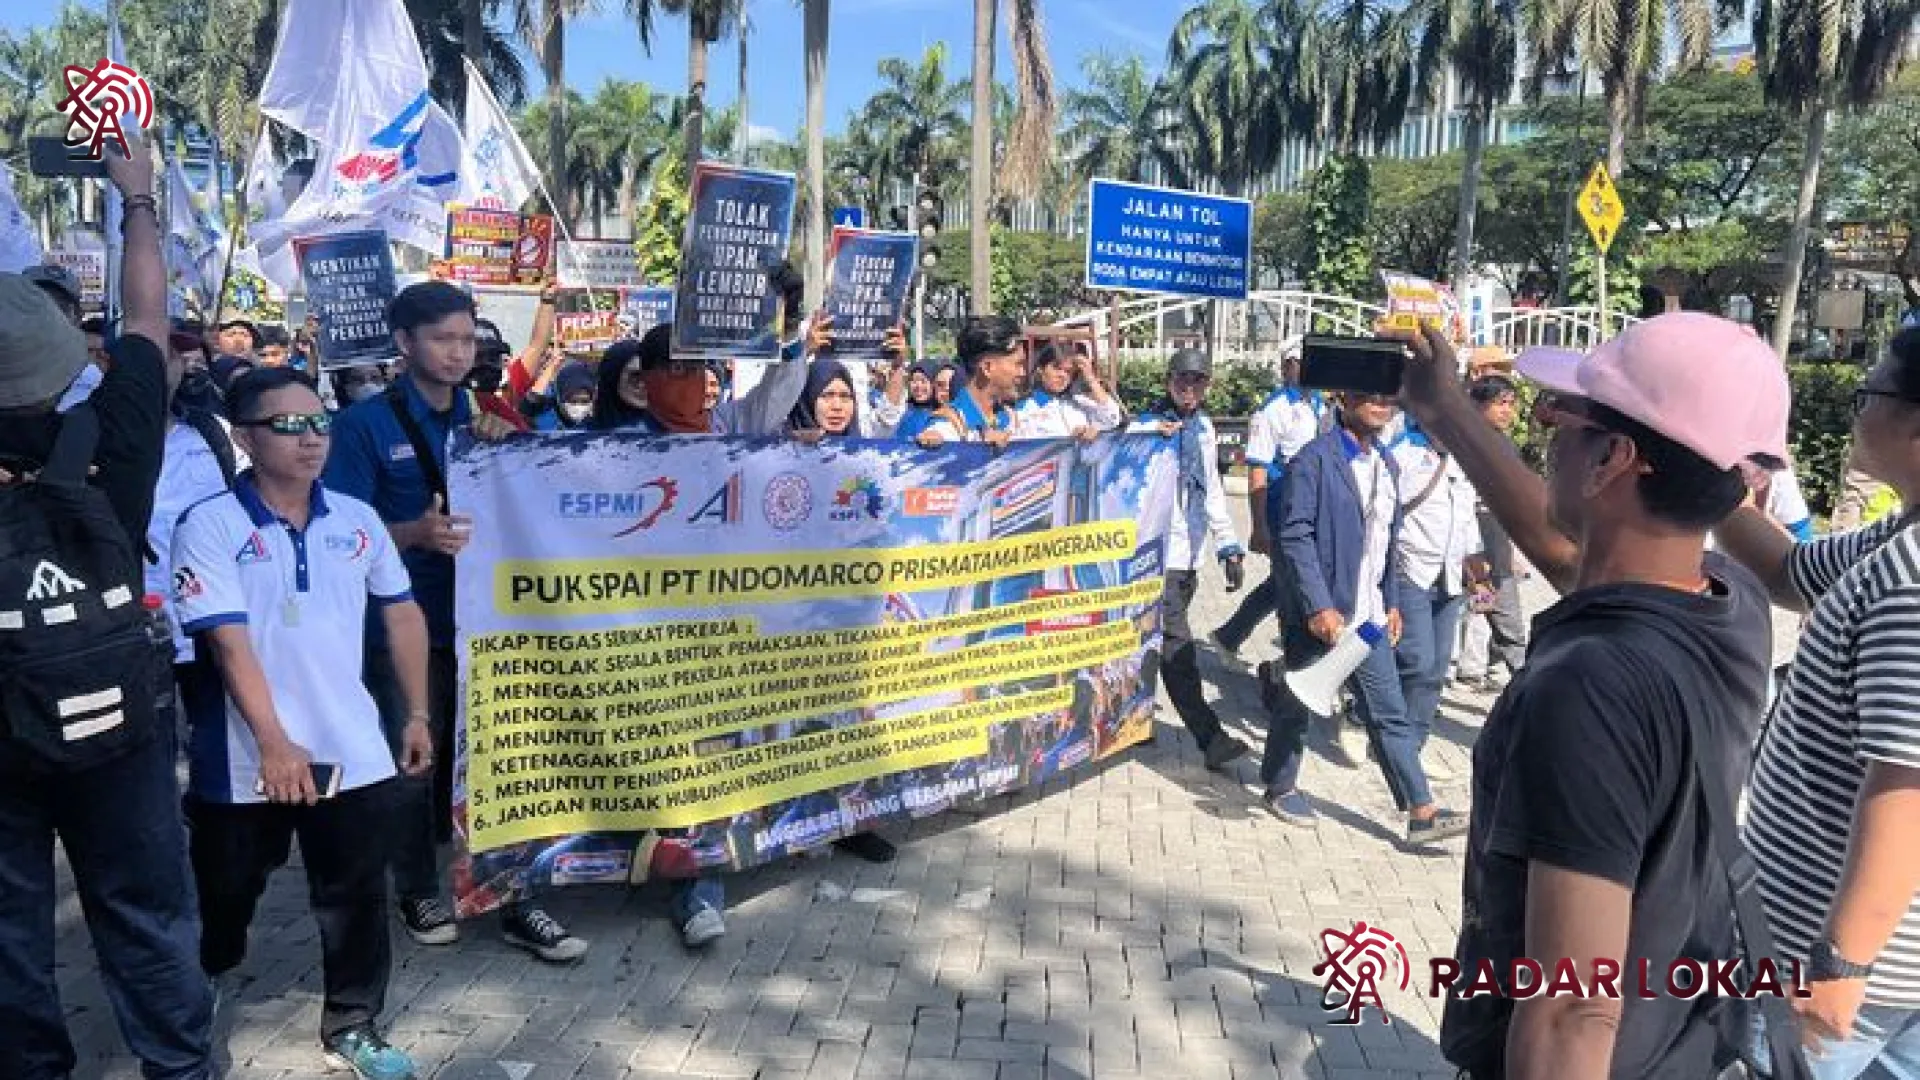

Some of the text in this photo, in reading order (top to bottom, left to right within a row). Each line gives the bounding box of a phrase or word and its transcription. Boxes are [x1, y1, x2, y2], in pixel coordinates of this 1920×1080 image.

[715, 199, 771, 229] TOLAK
[1121, 197, 1222, 226] JALAN TOL
[1121, 224, 1222, 248] HANYA UNTUK
[310, 254, 380, 276] HENTIKAN
[713, 243, 758, 269] UPAH
[1096, 240, 1243, 270] KENDARAAN BERMOTOR
[696, 270, 767, 297] LEMBUR
[1093, 262, 1243, 291] RODA EMPAT ATAU LEBIH
[337, 284, 366, 300] DAN
[329, 322, 390, 342] PEKERJA
[698, 314, 755, 330] NASIONAL
[558, 492, 643, 517] FSPMI
[511, 530, 1129, 604] PUK SPAI PT INDOMARCO PRISMATAMA TANGERANG
[471, 634, 530, 656] SIKAP
[534, 632, 602, 651] TEGAS
[605, 626, 664, 648] SERIKAT
[666, 620, 738, 642] PEKERJA
[472, 641, 922, 706] 2. MENEGASKAN HAK PEKERJA ATAS UPAH KERJA LEMBUR
[492, 658, 599, 677] MENOLAK
[605, 653, 662, 673] SEGALA
[665, 645, 723, 665] BENTUK
[492, 706, 599, 727] MENOLAK
[605, 690, 715, 722] PENGGANTIAN
[716, 686, 747, 704] HAK
[750, 676, 810, 698] LEMBUR
[813, 670, 871, 690] DENGAN
[874, 664, 900, 680] OFF
[492, 731, 605, 754] MENUNTUT
[612, 717, 703, 743] KEPATUHAN
[706, 697, 801, 728] PERUSAHAAN
[803, 690, 873, 714] TERHADAP
[876, 671, 949, 697] PERATURAN
[950, 658, 1035, 683] PERUSAHAAN
[473, 789, 489, 807] 5.
[495, 775, 606, 800] MENUNTUT
[764, 735, 836, 761] TERHADAP
[837, 724, 888, 746] OKNUM
[890, 718, 925, 738] YANG
[928, 700, 1013, 729] MELAKUKAN
[490, 743, 690, 776] KETENAGAKERJAAN
[473, 813, 491, 830] 6.
[496, 798, 585, 826] JANGAN
[590, 794, 661, 812] RUSAK
[665, 776, 744, 808] HUBUNGAN
[744, 759, 822, 787] INDUSTRIAL
[825, 743, 892, 770] DICABANG
